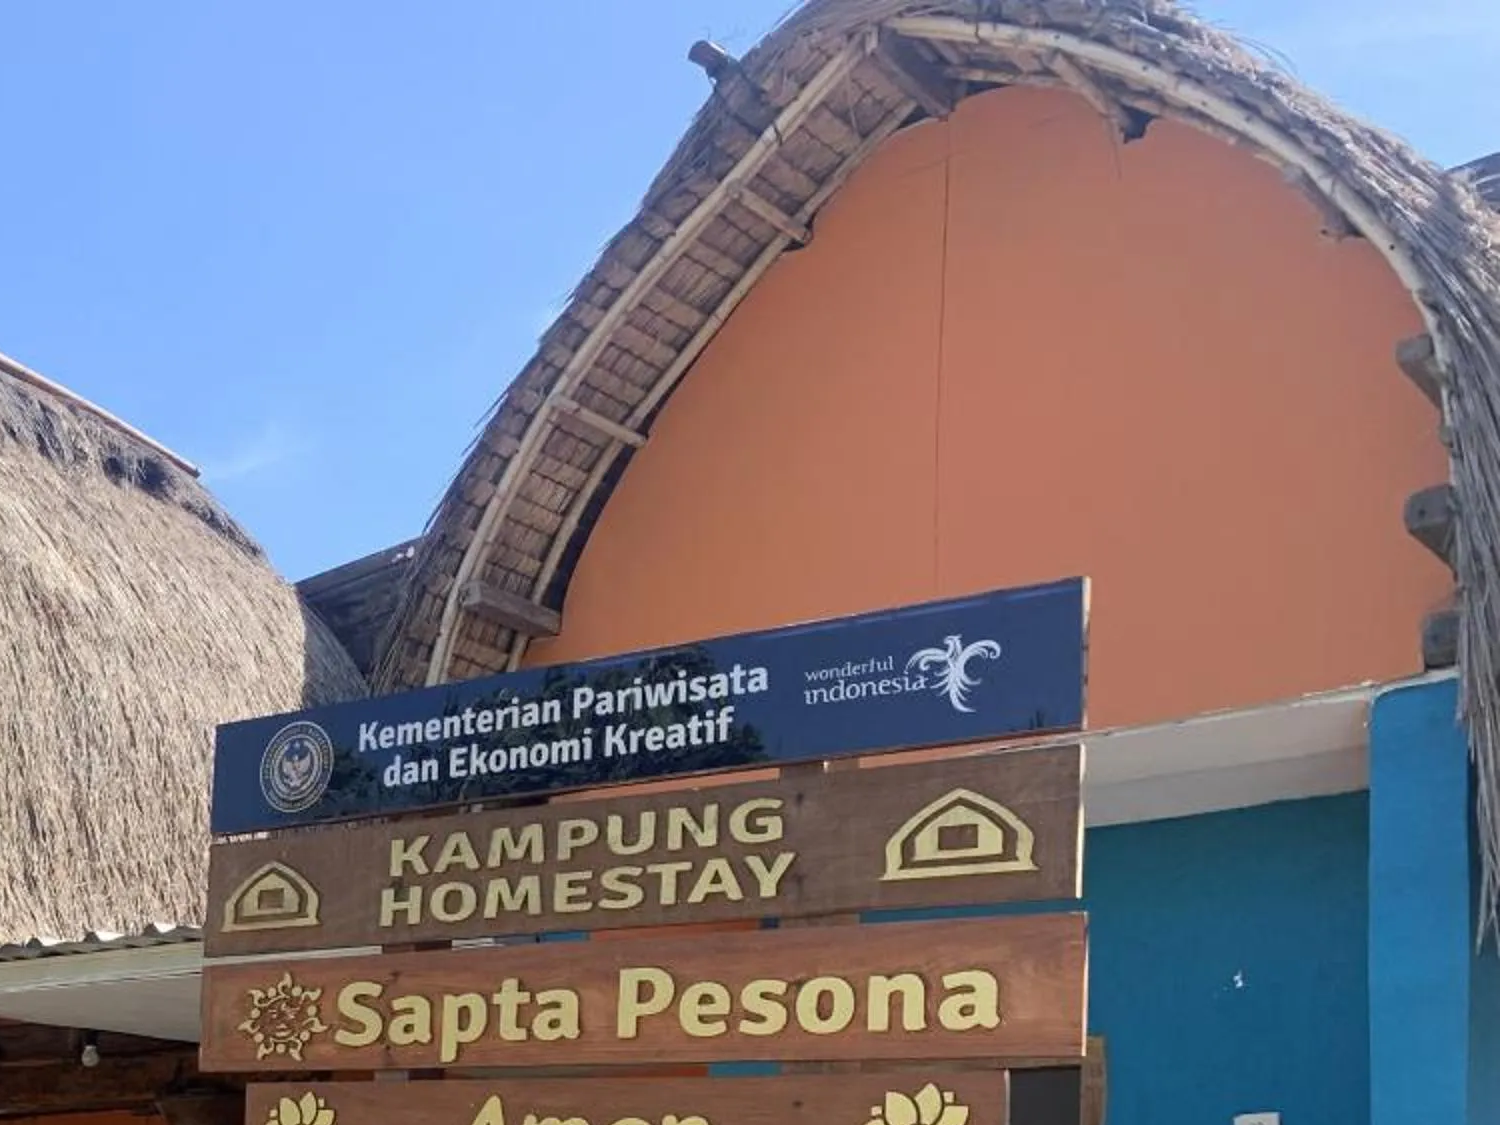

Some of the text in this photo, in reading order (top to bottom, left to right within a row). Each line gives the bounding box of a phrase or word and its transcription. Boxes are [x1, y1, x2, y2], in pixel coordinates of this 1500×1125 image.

[804, 672, 929, 704] indonesia
[805, 656, 895, 682] wonderful
[358, 663, 768, 753] Kementerian Pariwisata
[383, 755, 439, 787] dan
[449, 727, 592, 777] Ekonomi
[603, 706, 735, 758] Kreatif
[391, 798, 784, 875] KAMPUNG
[380, 852, 793, 926] HOMESTAY
[335, 967, 1001, 1062] Sapta Pesona
